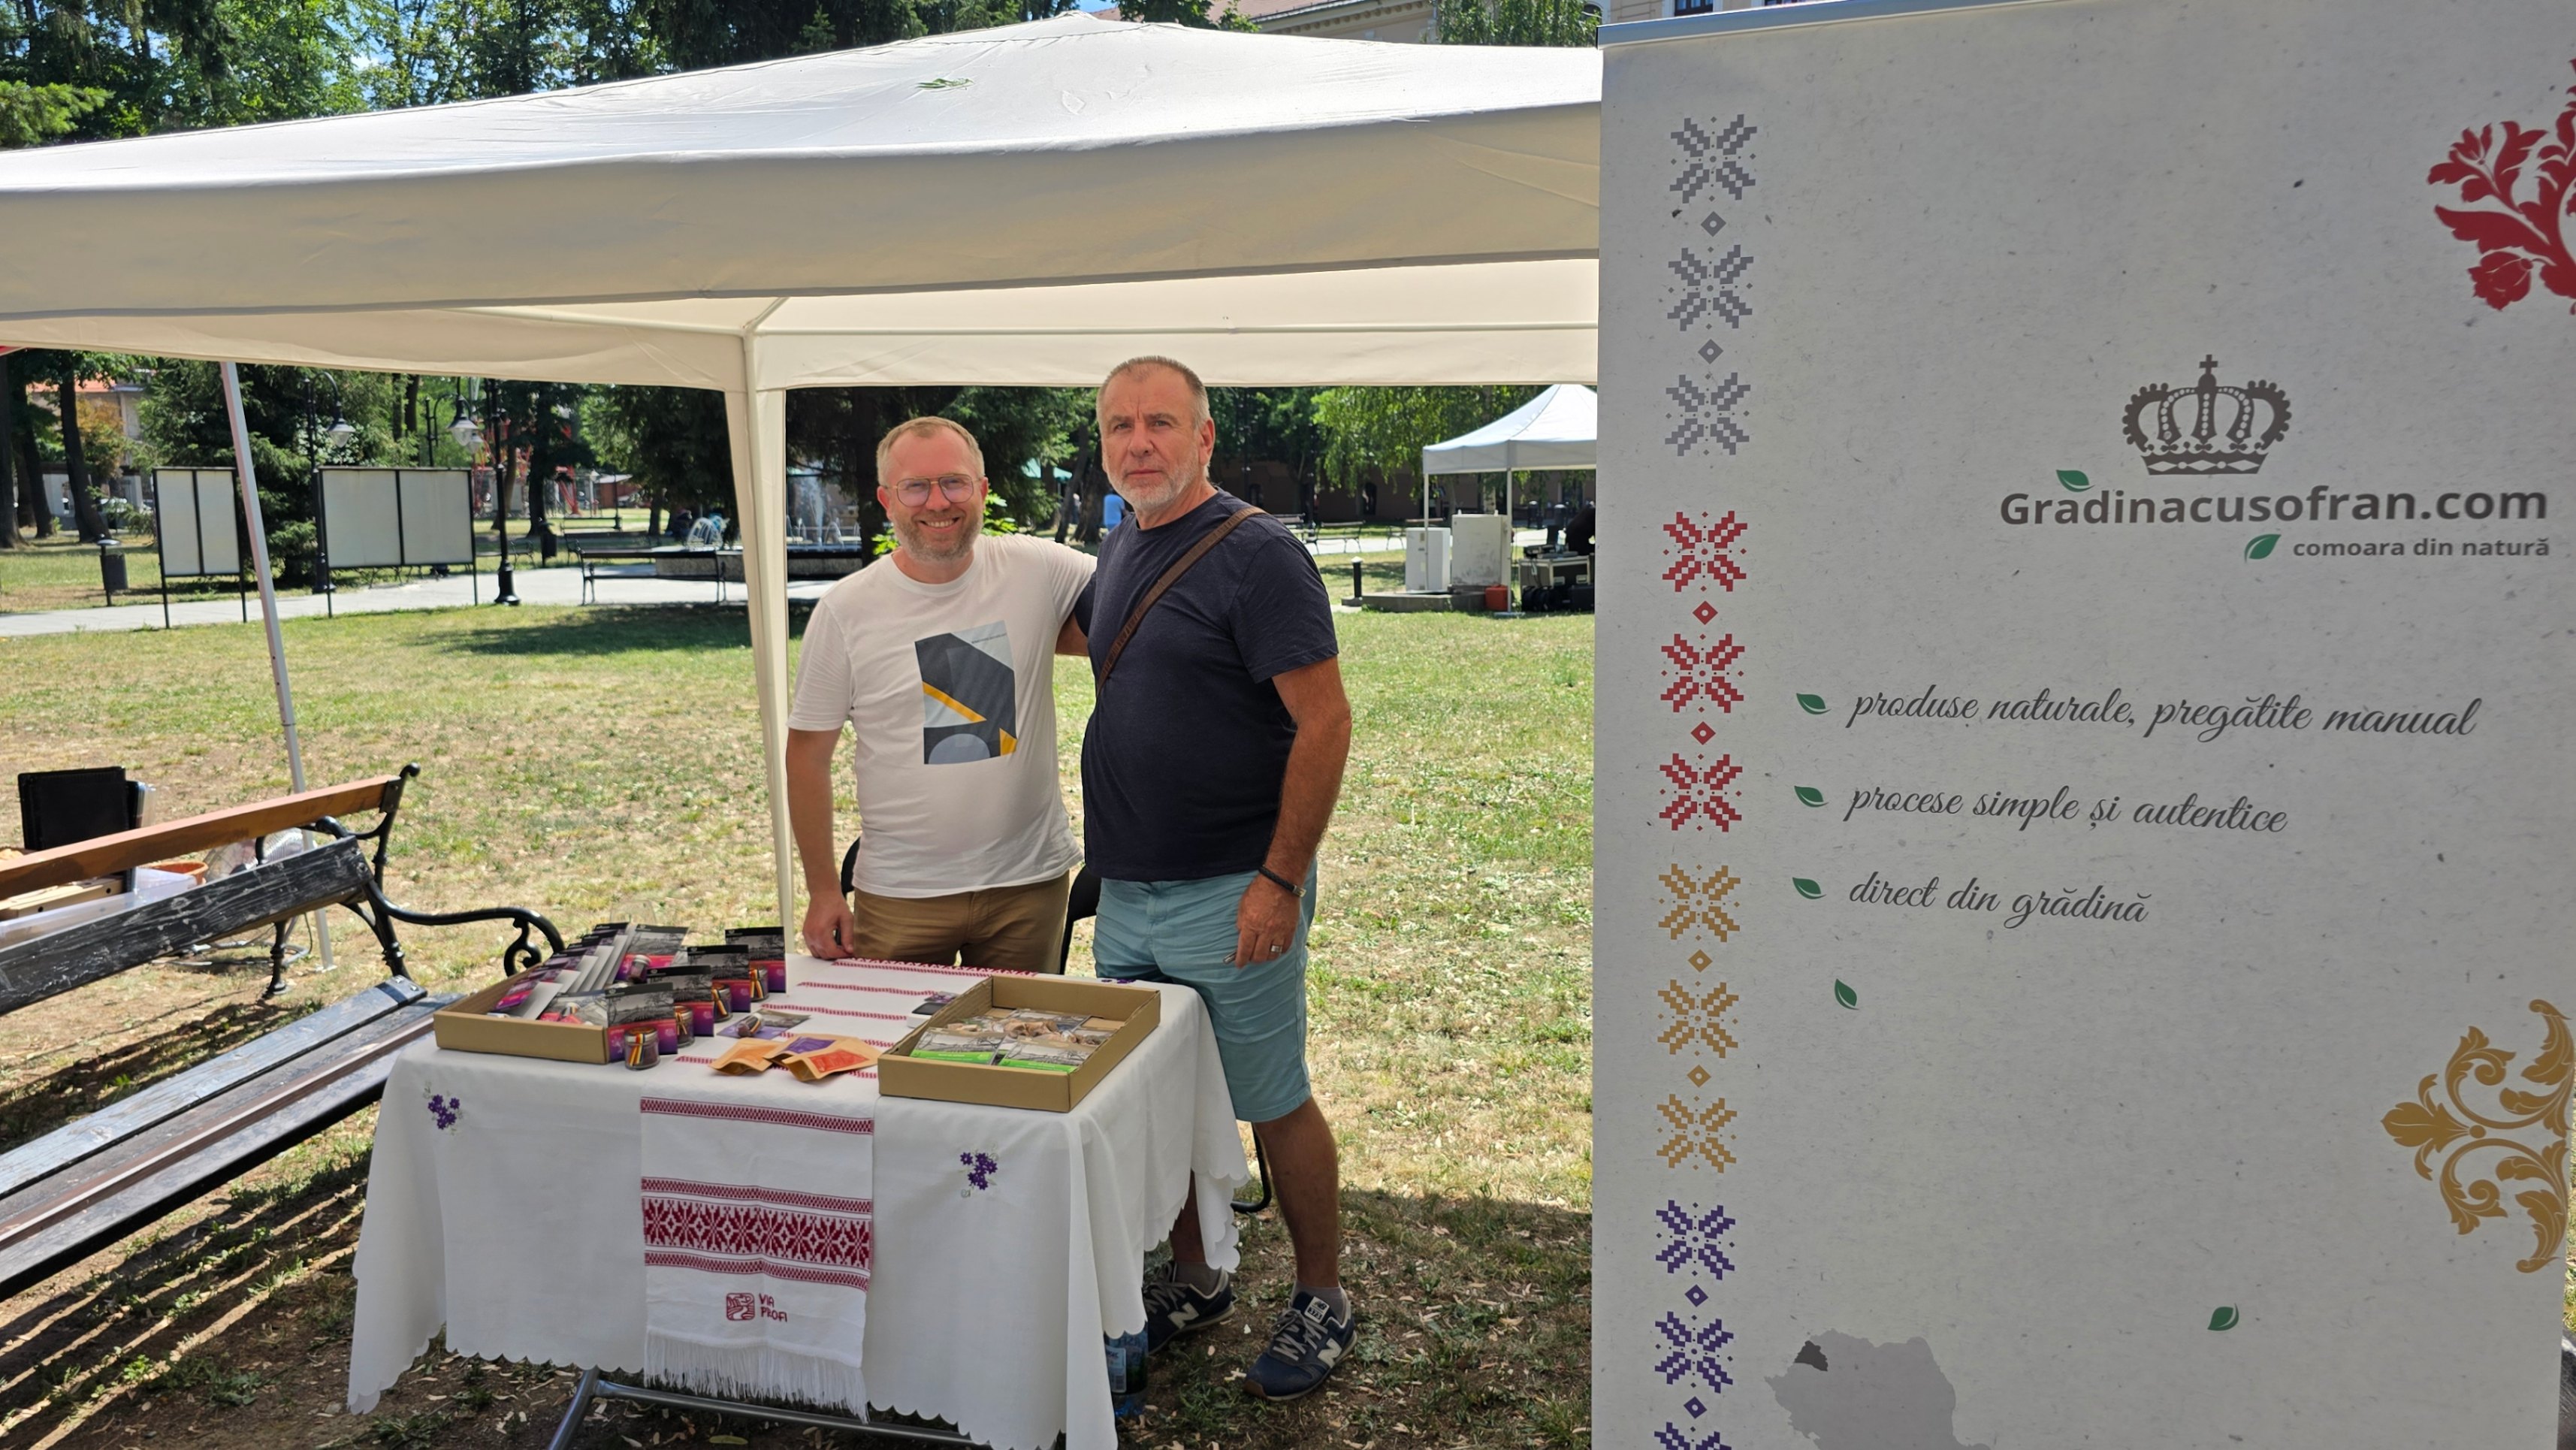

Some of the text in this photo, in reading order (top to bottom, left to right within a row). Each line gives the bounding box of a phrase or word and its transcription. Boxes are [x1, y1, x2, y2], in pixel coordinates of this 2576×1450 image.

[2001, 485, 2548, 525] Gradinacusofran.com
[2293, 537, 2550, 557] comoara din natură
[1845, 684, 2483, 743] produse naturale, pregătite manual
[1842, 785, 2289, 832] procese simple și autentice
[1849, 871, 2152, 929] direct din grădină
[759, 1293, 775, 1307] VIA
[760, 1307, 788, 1322] PROFI
